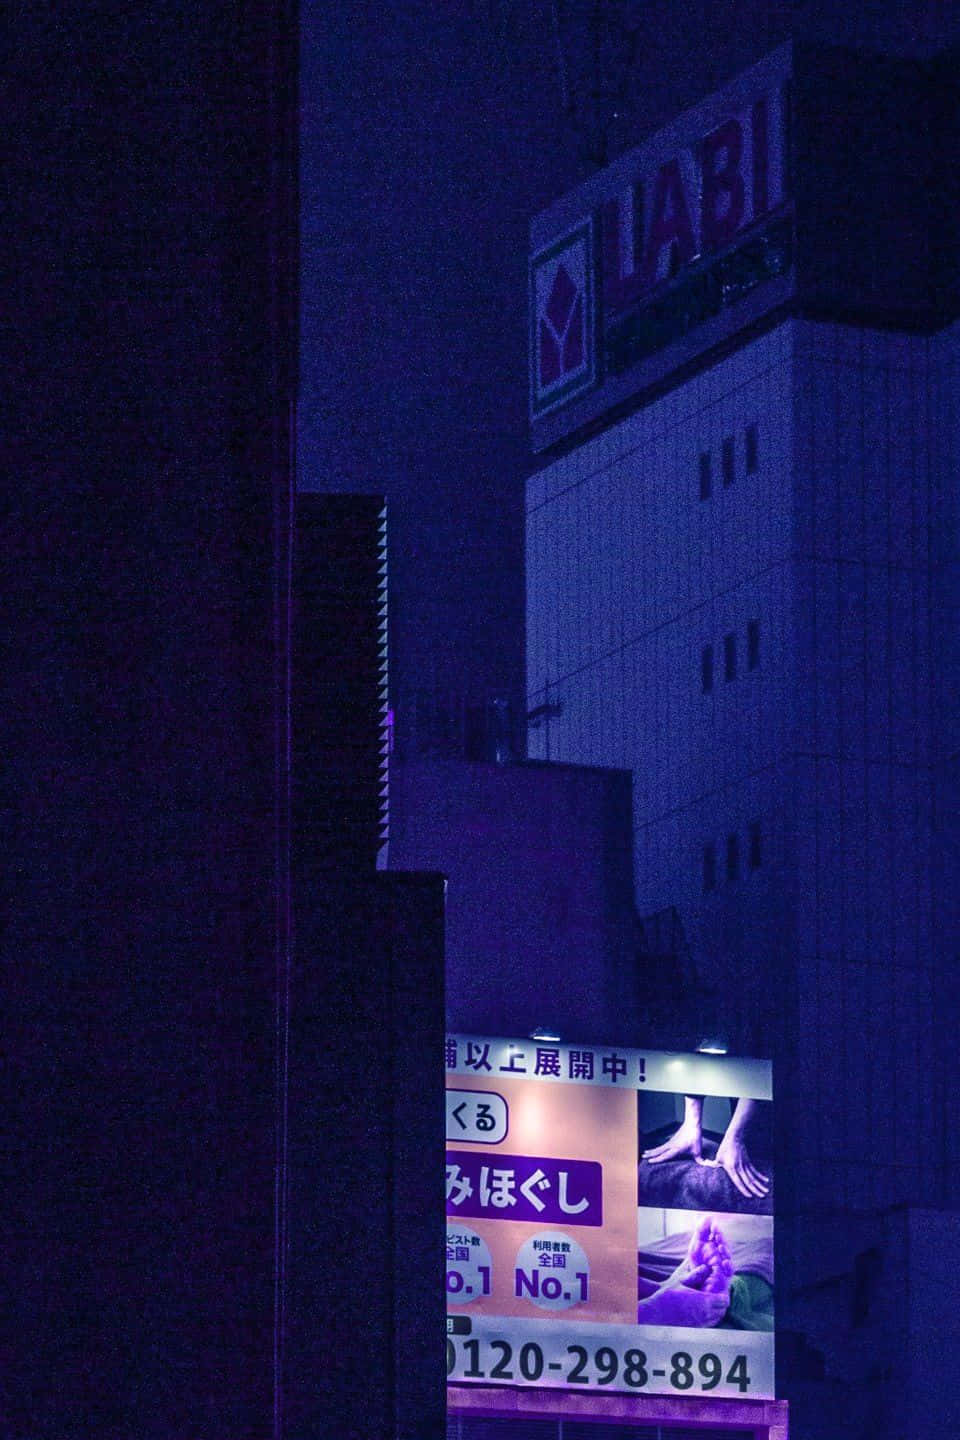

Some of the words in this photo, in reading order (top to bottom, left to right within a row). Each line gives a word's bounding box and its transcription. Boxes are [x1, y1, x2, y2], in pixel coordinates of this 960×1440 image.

[604, 95, 770, 300] LABI
[446, 1165, 590, 1214] みほぐし
[532, 1239, 572, 1254] 利用者数
[537, 1253, 566, 1269] 全国
[514, 1269, 588, 1301] No.1
